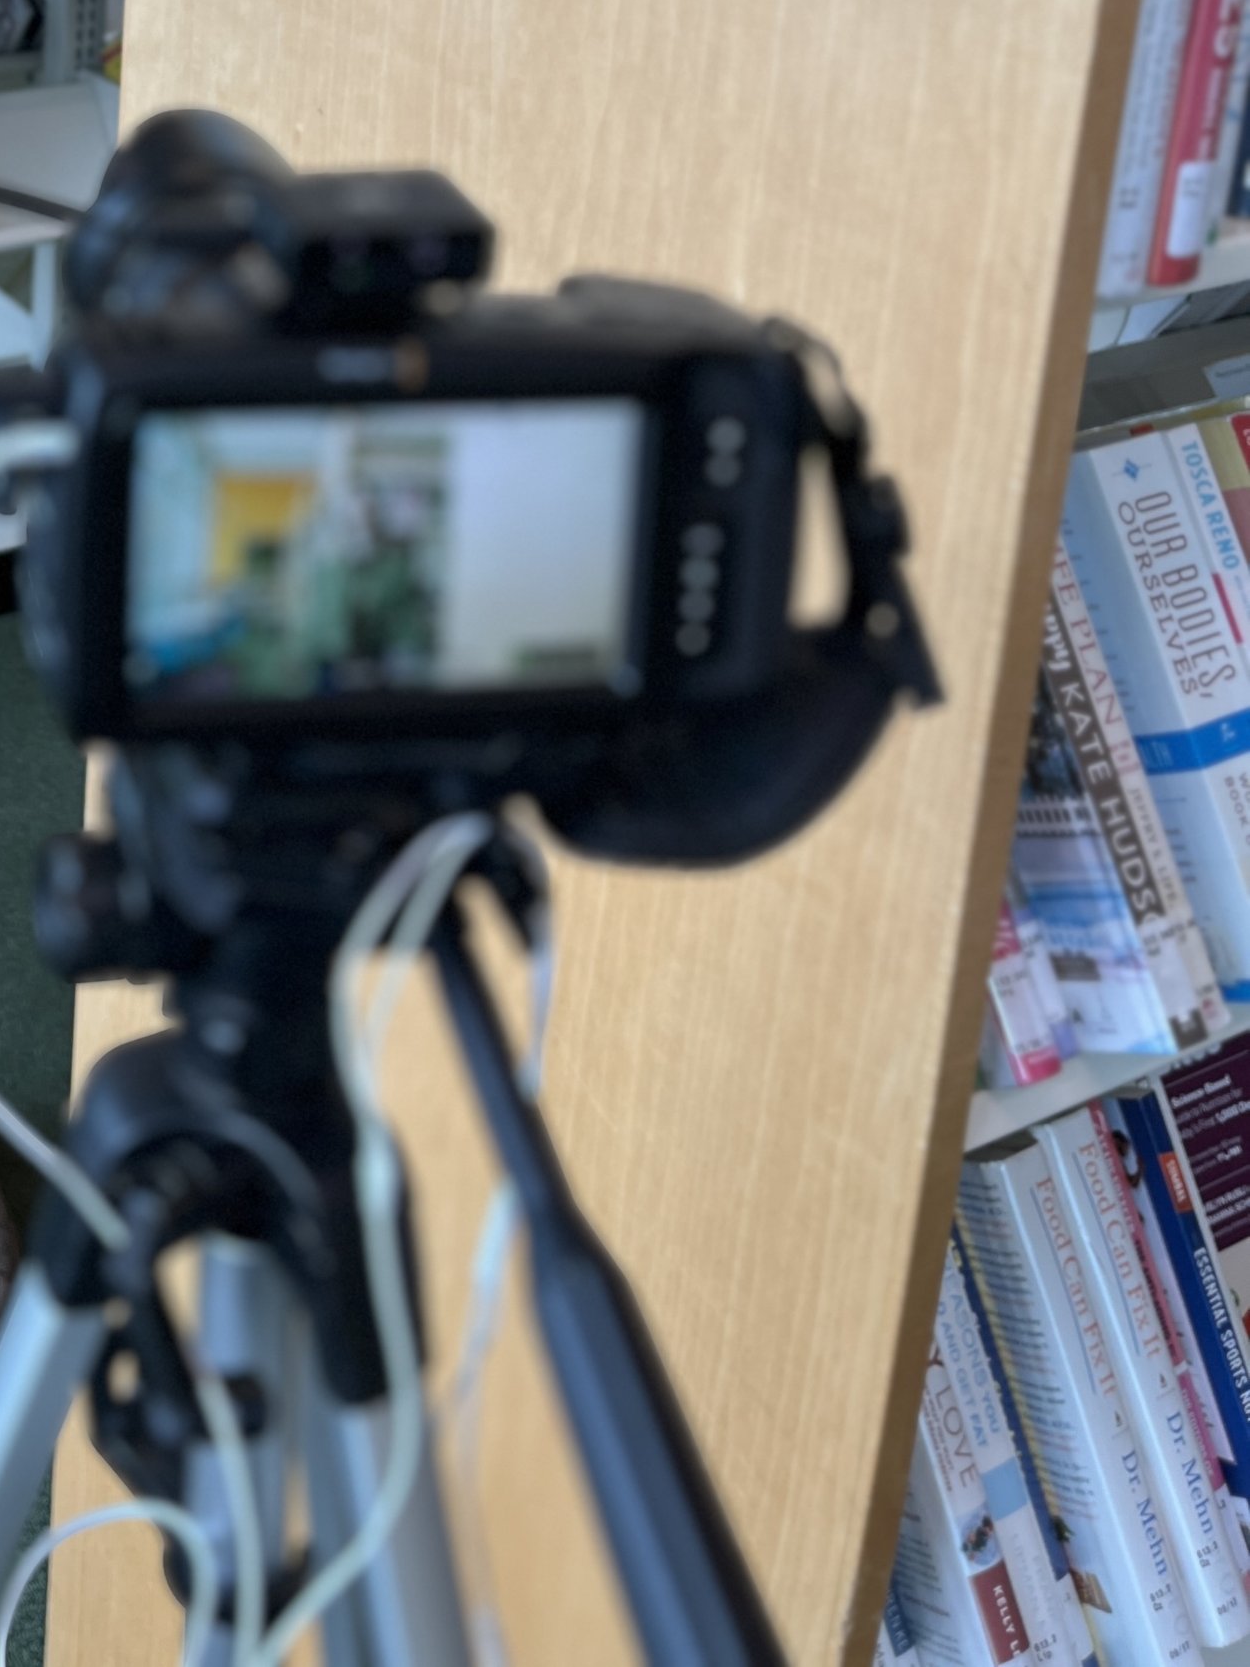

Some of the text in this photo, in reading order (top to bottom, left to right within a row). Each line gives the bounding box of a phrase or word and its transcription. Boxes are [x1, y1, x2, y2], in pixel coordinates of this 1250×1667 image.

[1180, 439, 1217, 507] TOSCA
[1205, 510, 1240, 572] RENO
[1116, 500, 1199, 696] OURSELVES
[1134, 490, 1237, 700] OUR BODIES,
[1070, 617, 1123, 726] PLAN
[1060, 681, 1112, 785] KATE
[1034, 1175, 1117, 1398] Food Can Fix It
[1078, 1139, 1116, 1215] Food
[1106, 1218, 1132, 1281] Can
[1127, 1284, 1151, 1334] Fix
[1142, 1334, 1161, 1358] It
[1192, 1245, 1228, 1334] ESSENTIAL
[1219, 1327, 1244, 1389] SPORTS
[935, 1385, 978, 1488] LOVE
[941, 1320, 962, 1364] AND
[954, 1366, 976, 1408] GET
[968, 1412, 989, 1448] FAT
[980, 1387, 1000, 1434] YOU
[1165, 1410, 1186, 1454] Dr.
[1121, 1448, 1141, 1494] Dr.
[993, 1585, 1016, 1634] KELLY
